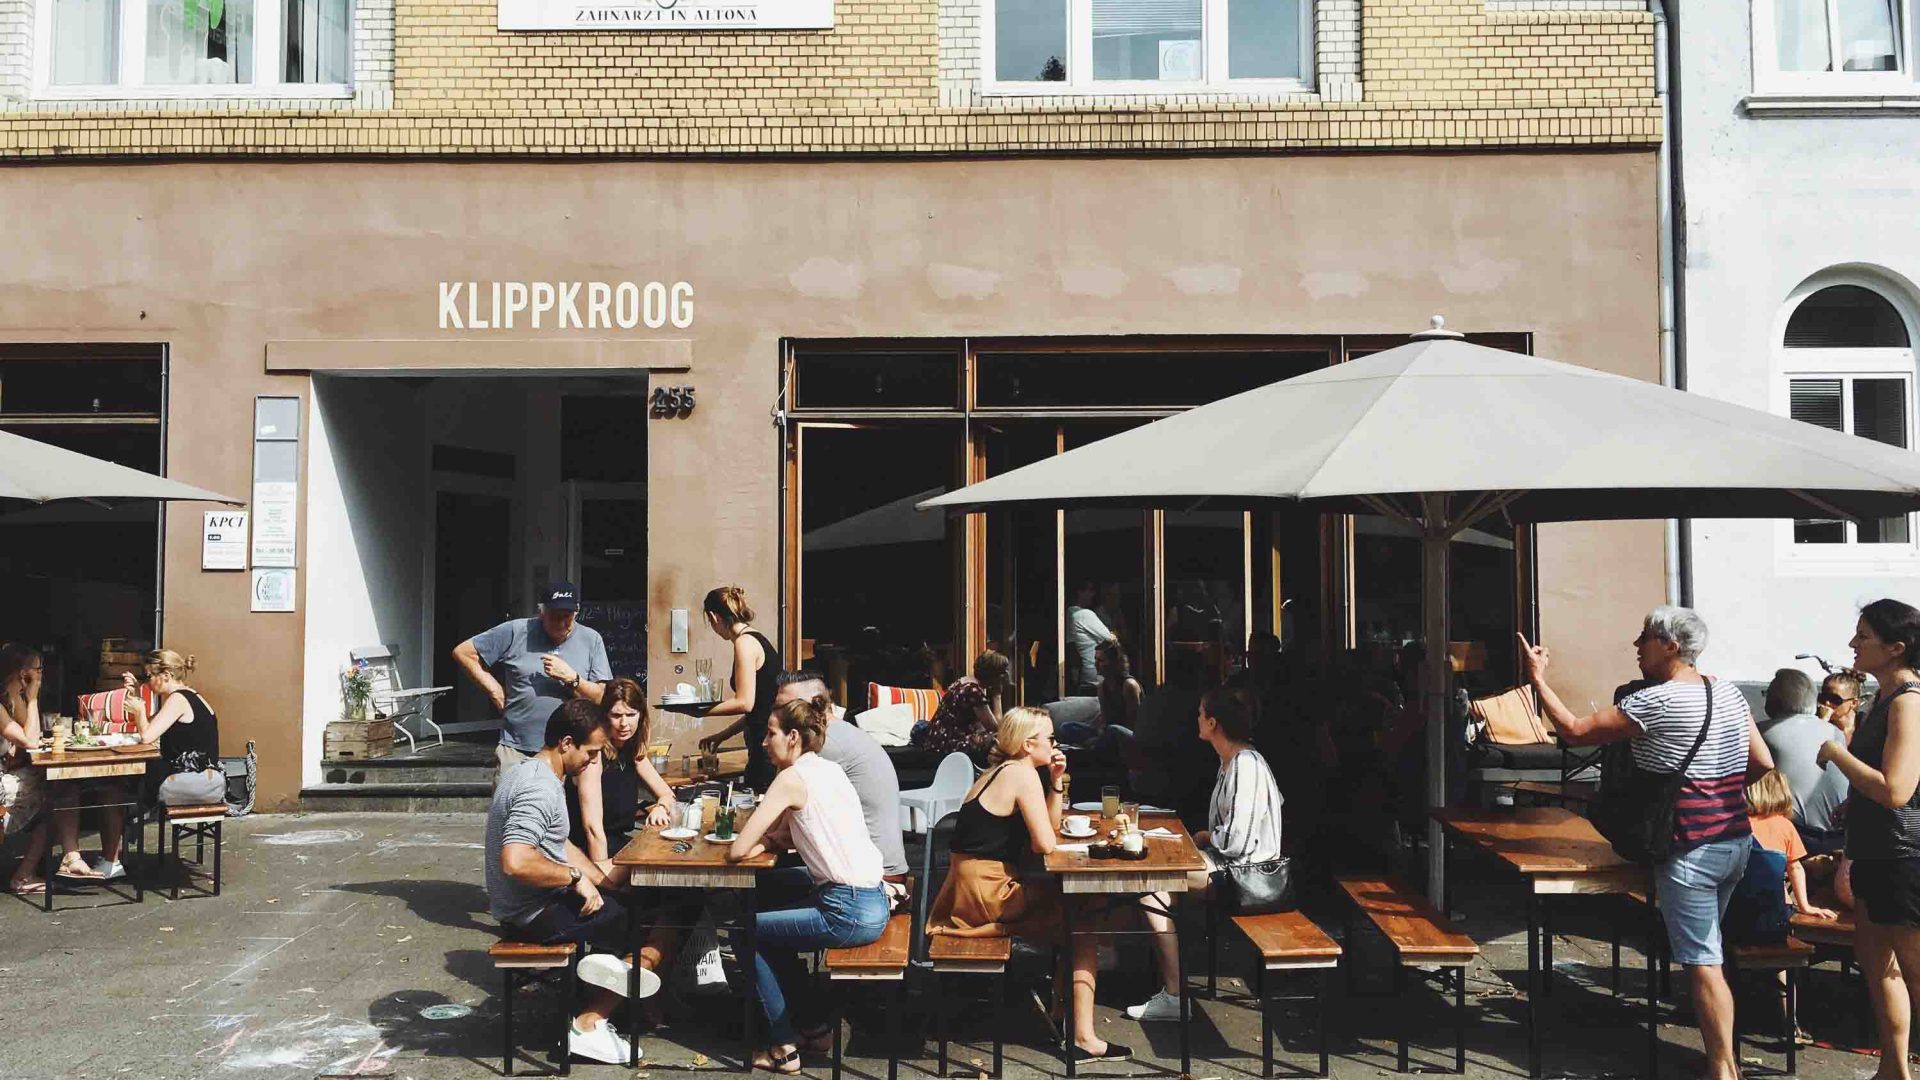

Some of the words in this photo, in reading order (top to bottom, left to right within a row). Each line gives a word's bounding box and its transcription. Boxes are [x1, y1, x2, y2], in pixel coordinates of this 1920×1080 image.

[575, 9, 663, 21] ZAHNARZT
[671, 9, 687, 21] IN
[694, 9, 757, 21] ALTONA
[438, 281, 695, 329] KLIPPKROOG
[653, 386, 695, 410] 255
